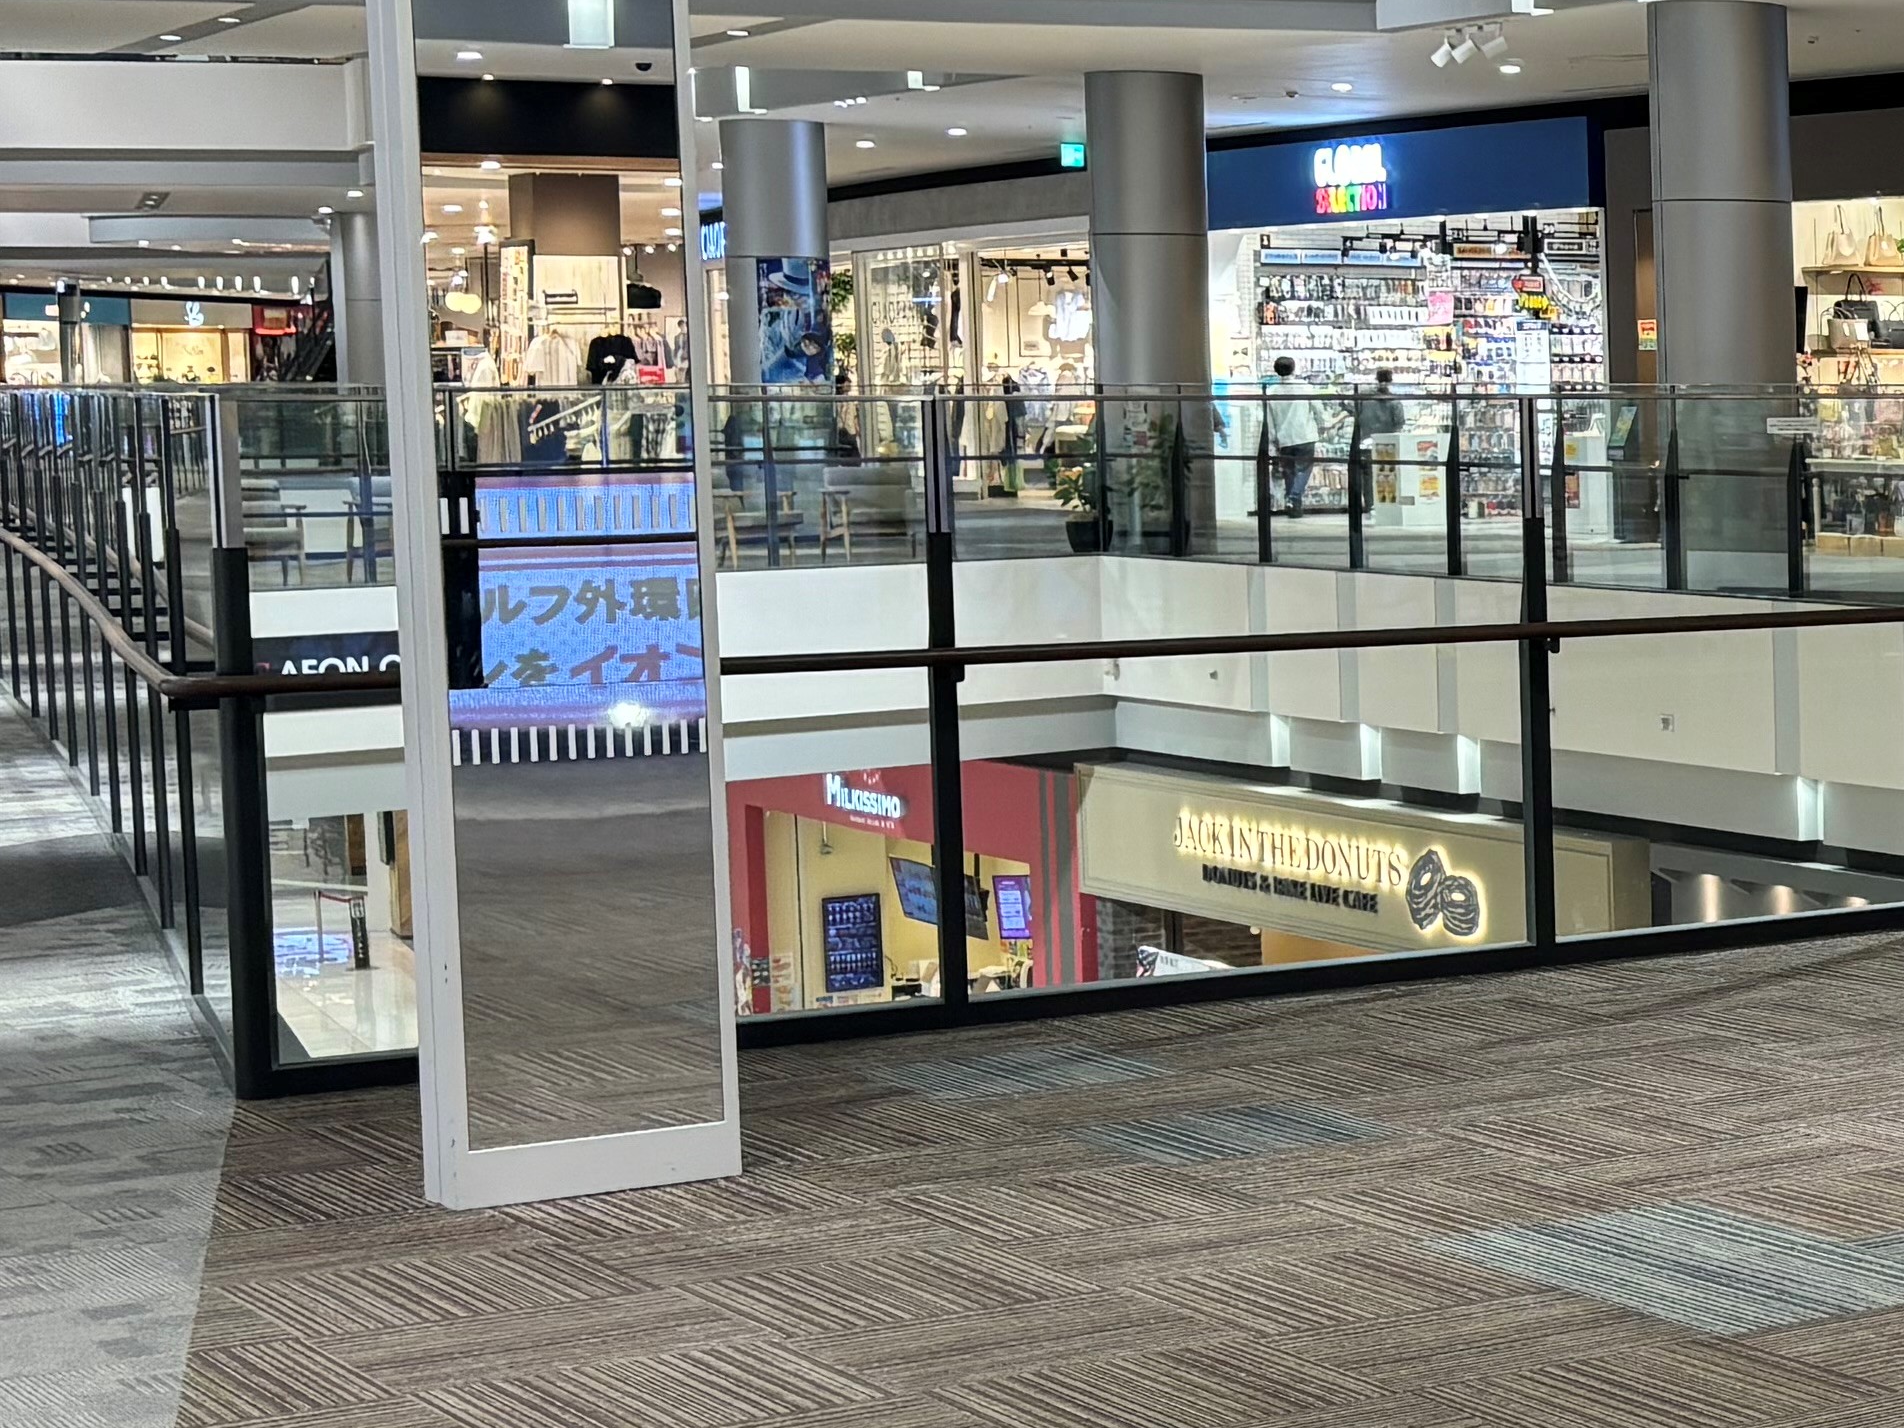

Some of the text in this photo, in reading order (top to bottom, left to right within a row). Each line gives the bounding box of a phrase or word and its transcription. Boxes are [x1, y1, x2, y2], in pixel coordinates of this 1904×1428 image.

[482, 576, 698, 625] ルフ外環
[1173, 816, 1402, 887] JACK IN THE DONUTS
